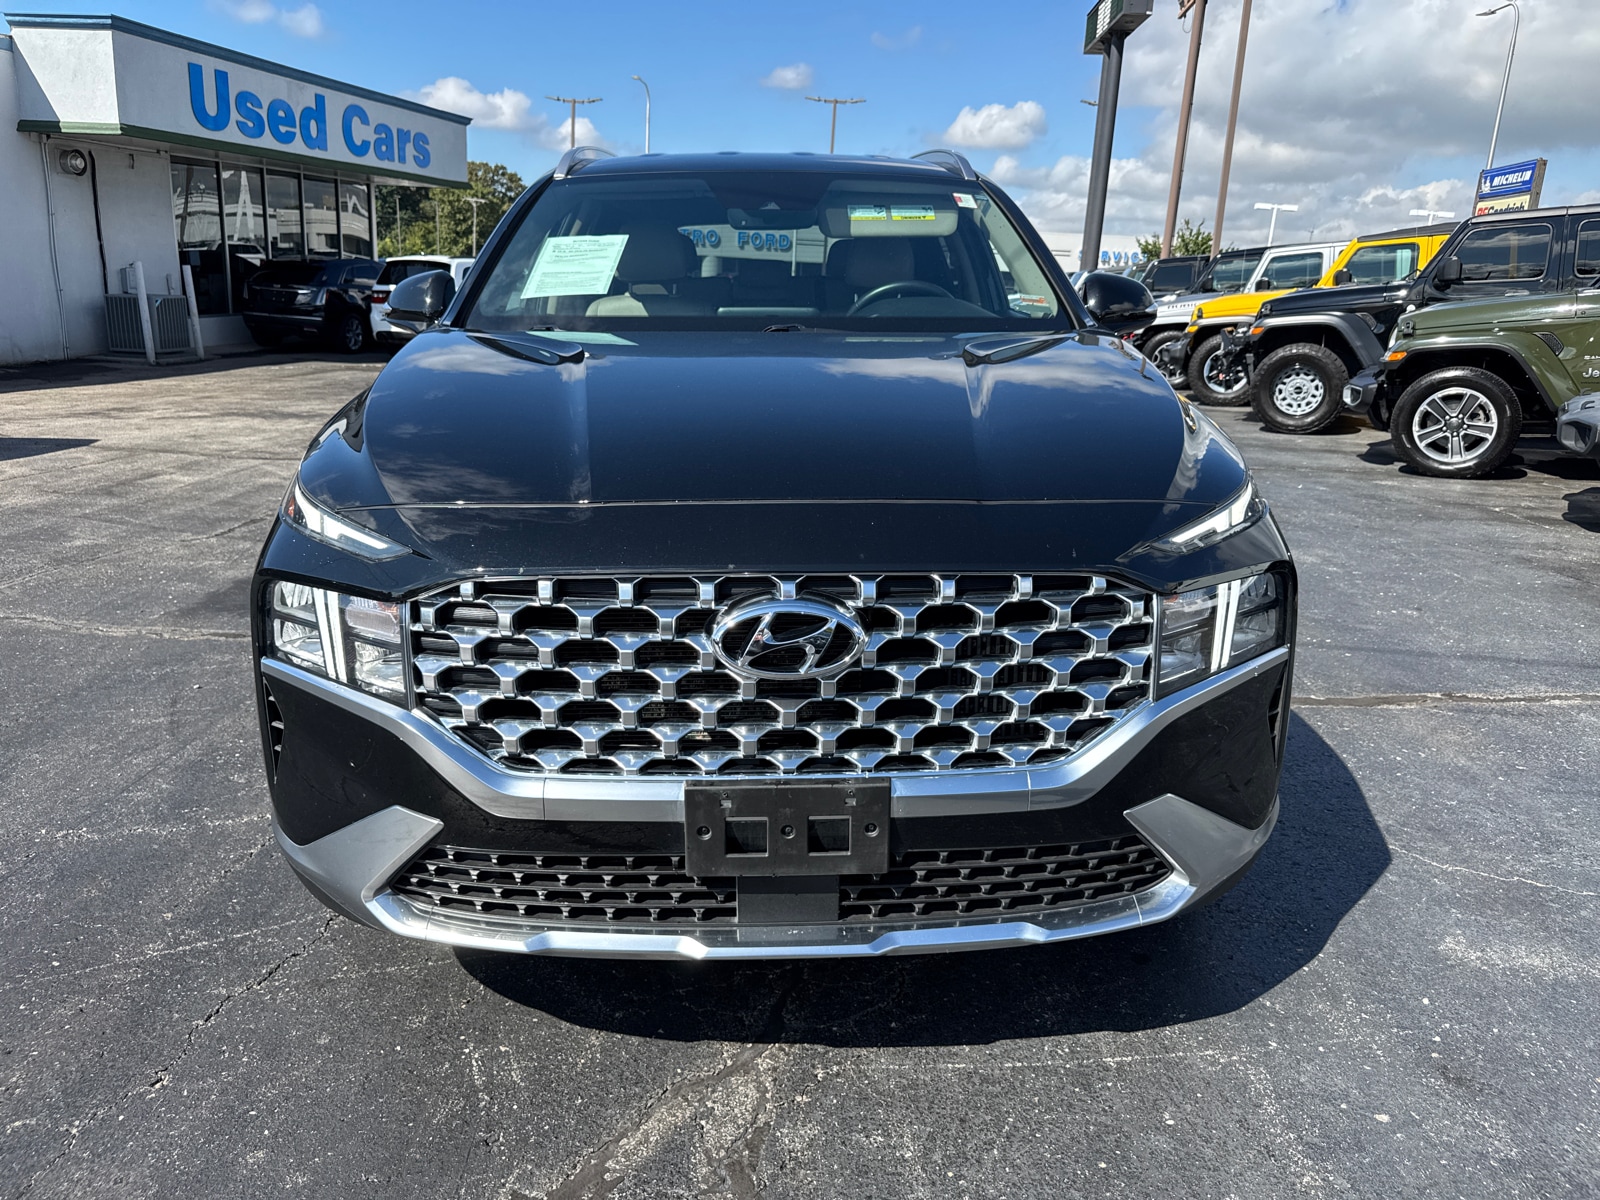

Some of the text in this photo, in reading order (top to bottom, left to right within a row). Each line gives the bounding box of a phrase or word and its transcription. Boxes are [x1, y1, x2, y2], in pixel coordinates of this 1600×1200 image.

[187, 62, 432, 169] Used Cars
[1492, 170, 1532, 187] MICHELIN
[737, 231, 791, 250] FORD
[1582, 367, 1600, 378] Je
